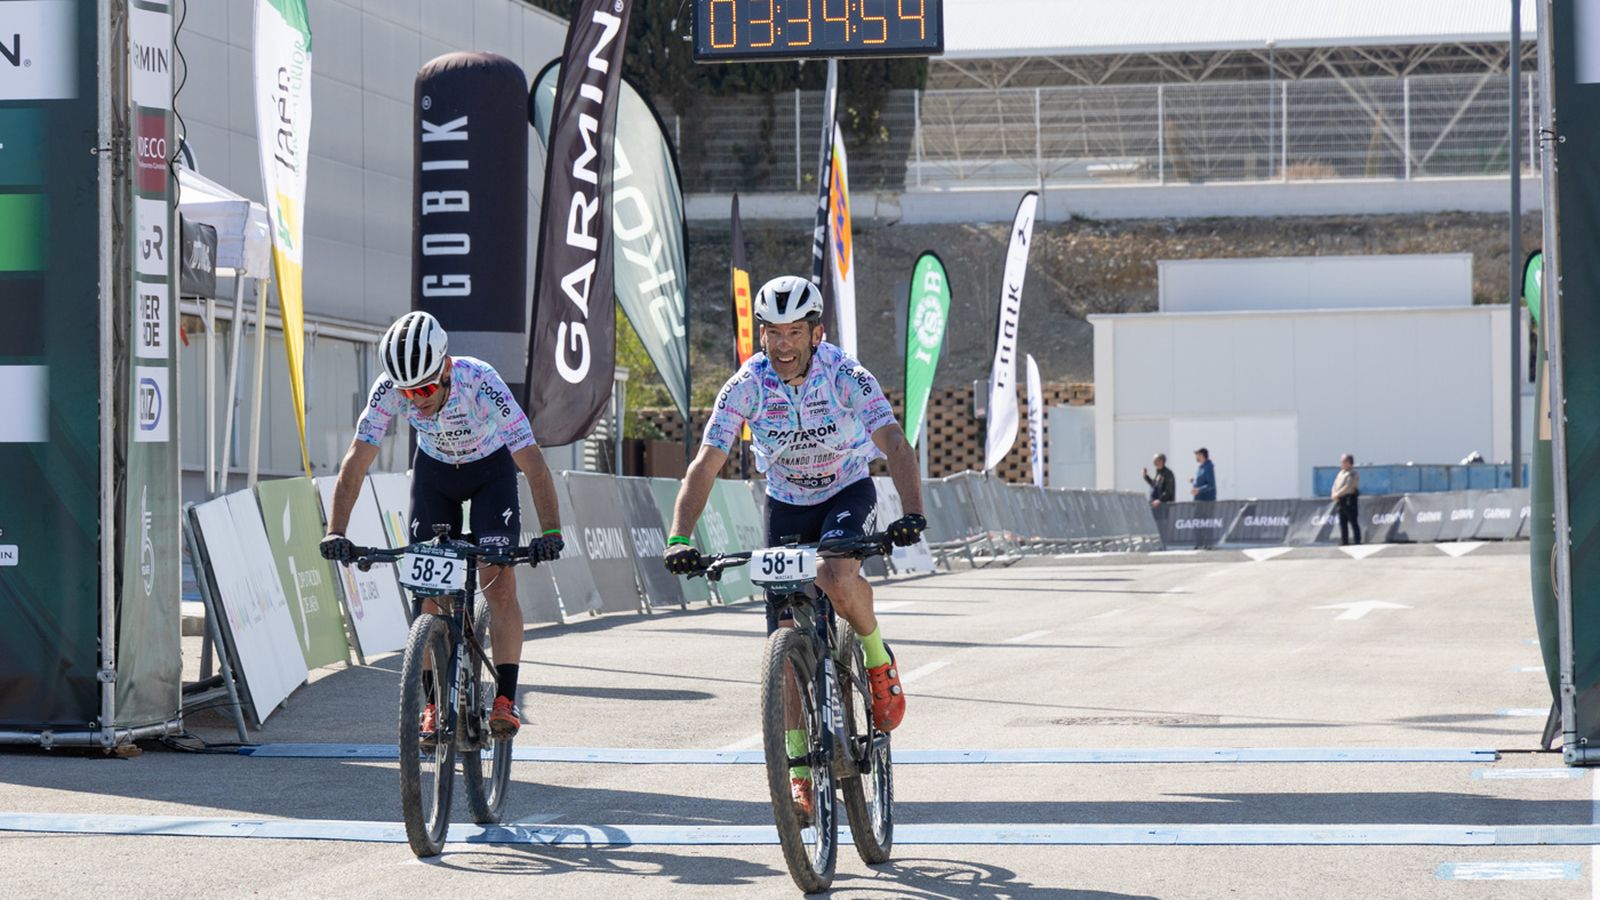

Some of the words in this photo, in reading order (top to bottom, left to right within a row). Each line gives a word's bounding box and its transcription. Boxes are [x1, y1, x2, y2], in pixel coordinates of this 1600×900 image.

[709, 0, 925, 48] 03:34:54
[422, 115, 472, 298] GOBIK
[555, 10, 621, 384] GARMIN
[369, 379, 395, 409] code
[839, 363, 873, 396] codere
[480, 381, 512, 418] codere
[1175, 517, 1223, 530] GARMIN
[1243, 515, 1290, 527] GARMIN
[584, 526, 628, 560] GARMIN
[411, 556, 454, 584] 58-2
[762, 551, 804, 576] 58-1
